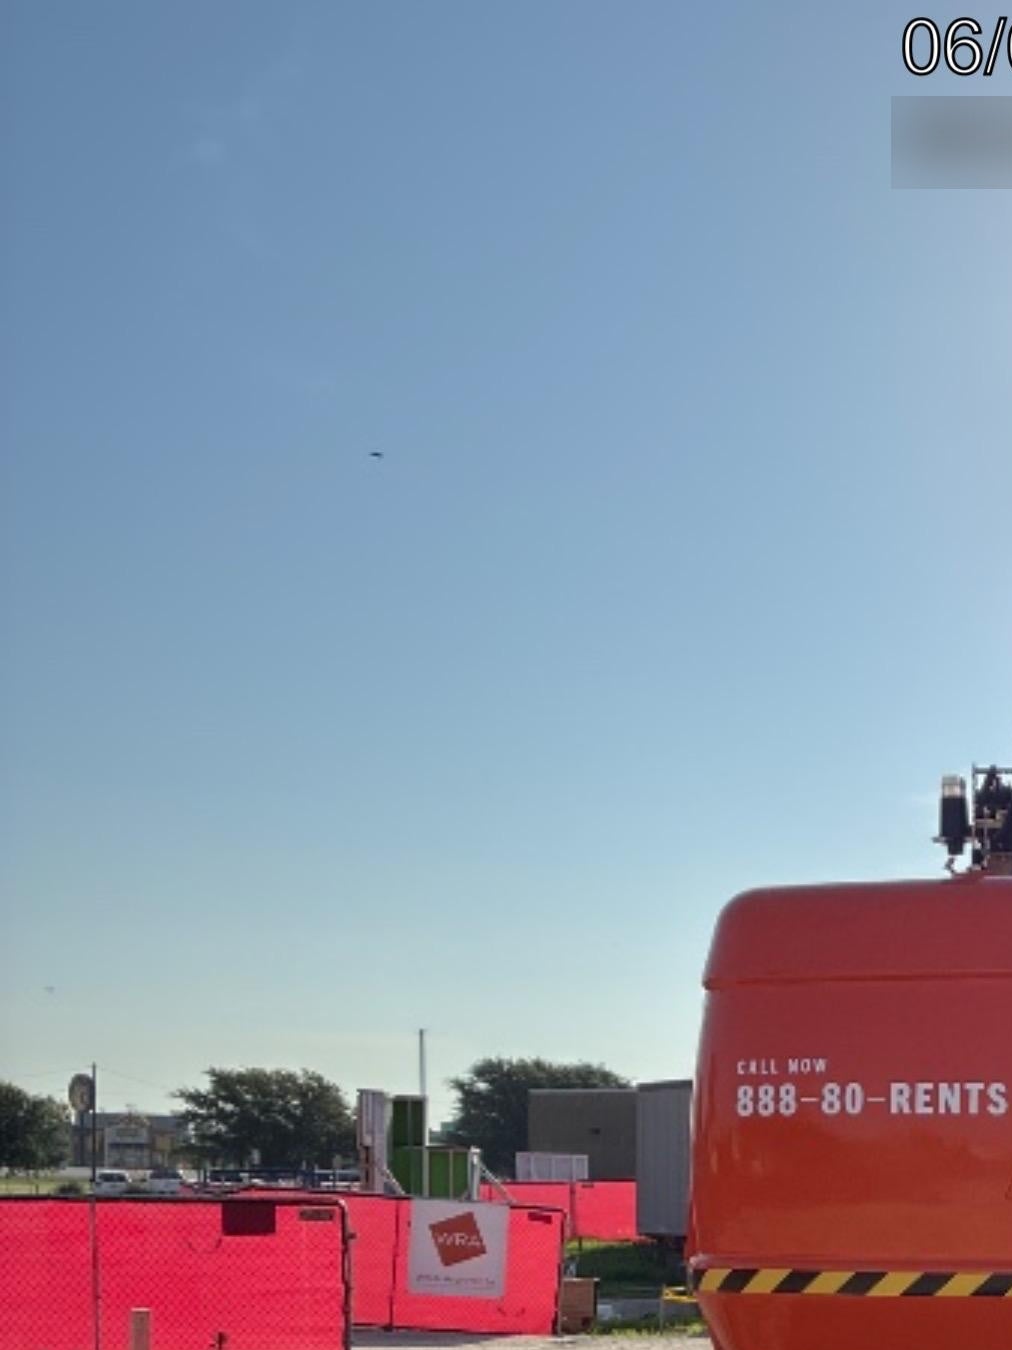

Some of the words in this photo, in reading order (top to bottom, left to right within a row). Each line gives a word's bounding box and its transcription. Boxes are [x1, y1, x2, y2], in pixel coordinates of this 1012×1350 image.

[737, 1060, 778, 1075] CALL
[788, 1058, 827, 1075] NOW
[737, 1082, 1008, 1117] 888-80-RENTS
